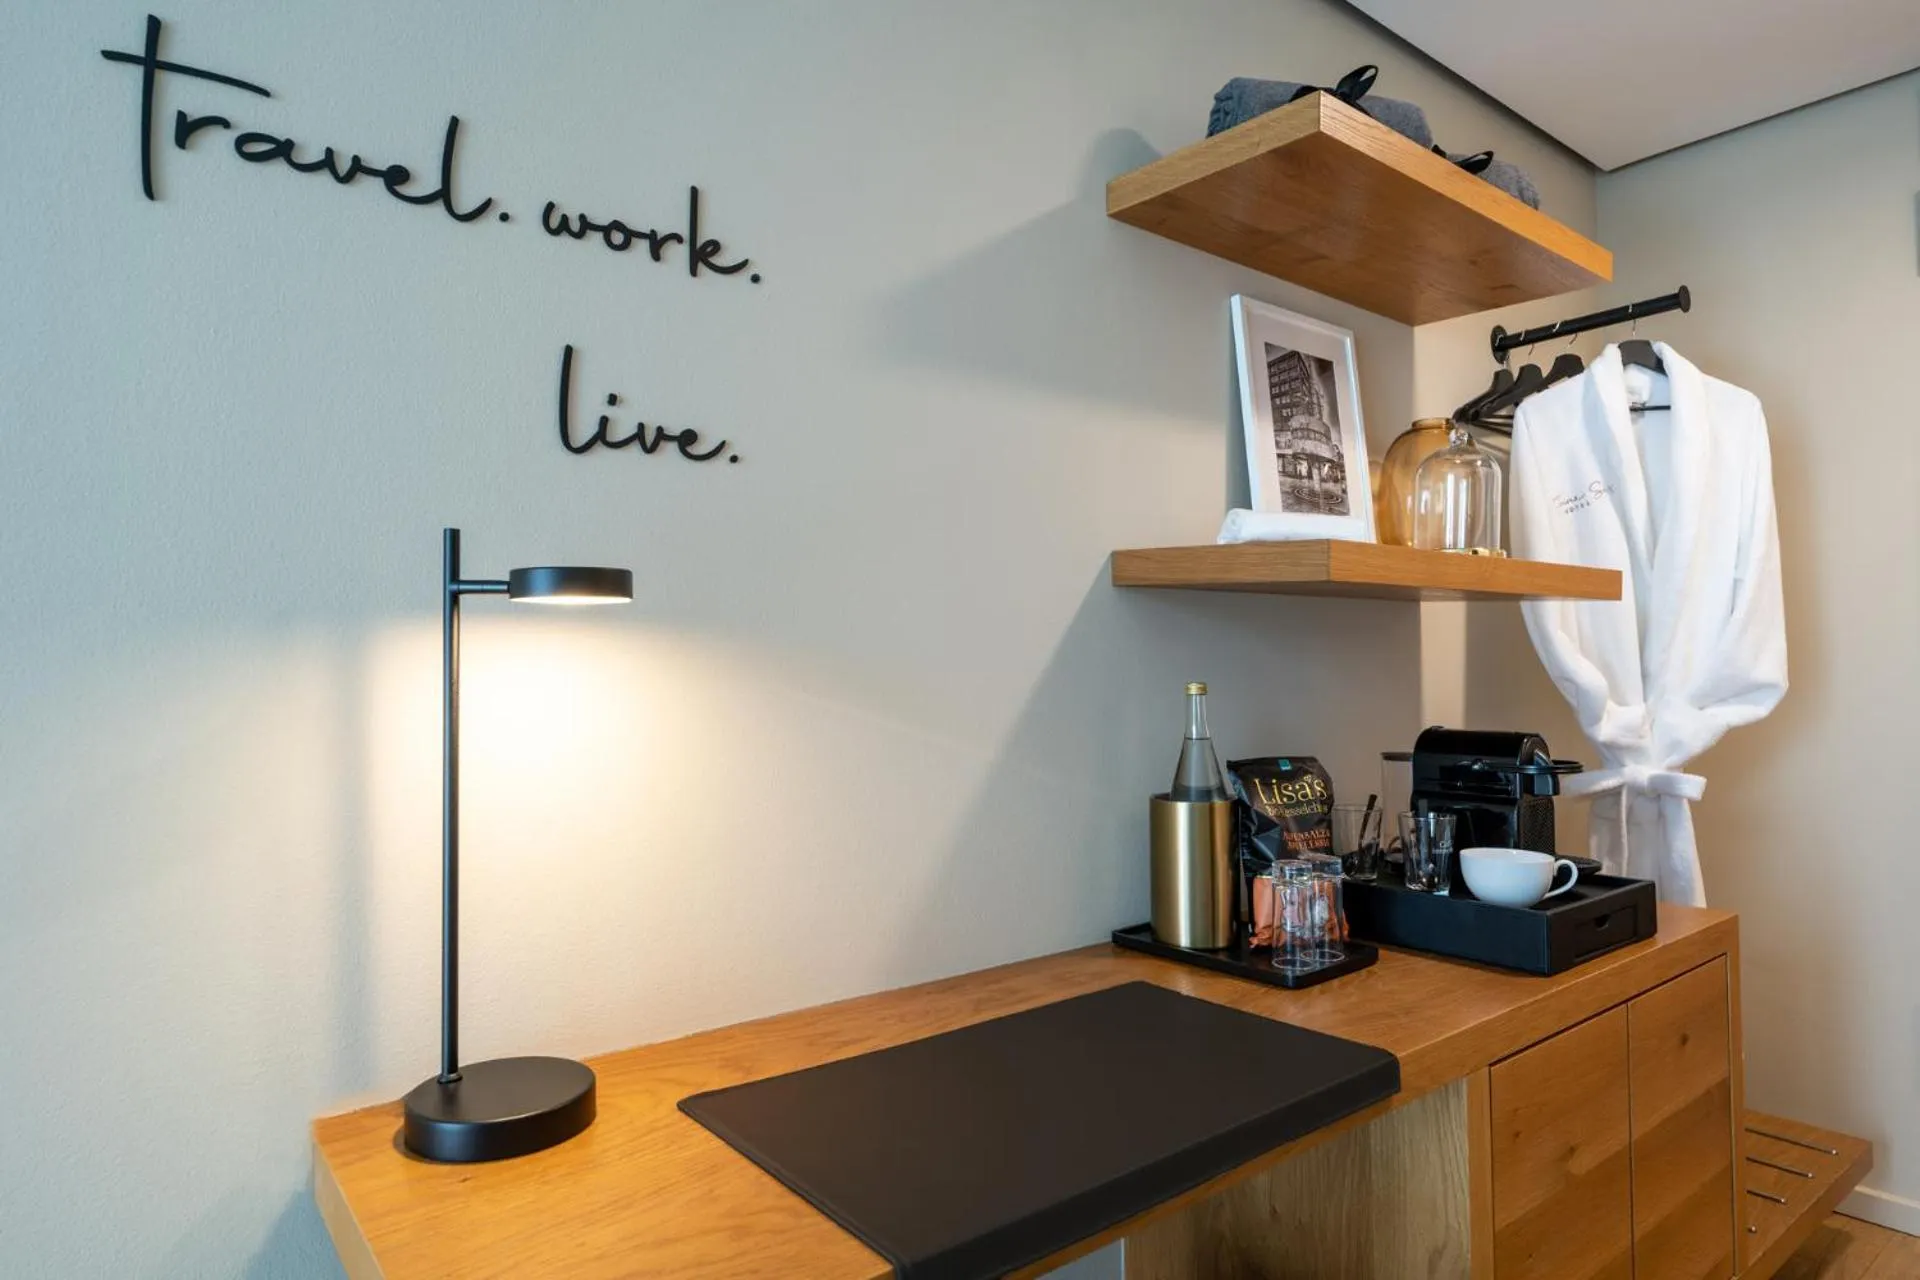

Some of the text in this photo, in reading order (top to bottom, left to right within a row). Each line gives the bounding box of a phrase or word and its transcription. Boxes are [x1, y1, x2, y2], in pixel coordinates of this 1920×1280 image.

[543, 186, 761, 284] work.
[558, 344, 739, 463] live.
[1254, 775, 1328, 805] Lisa's
